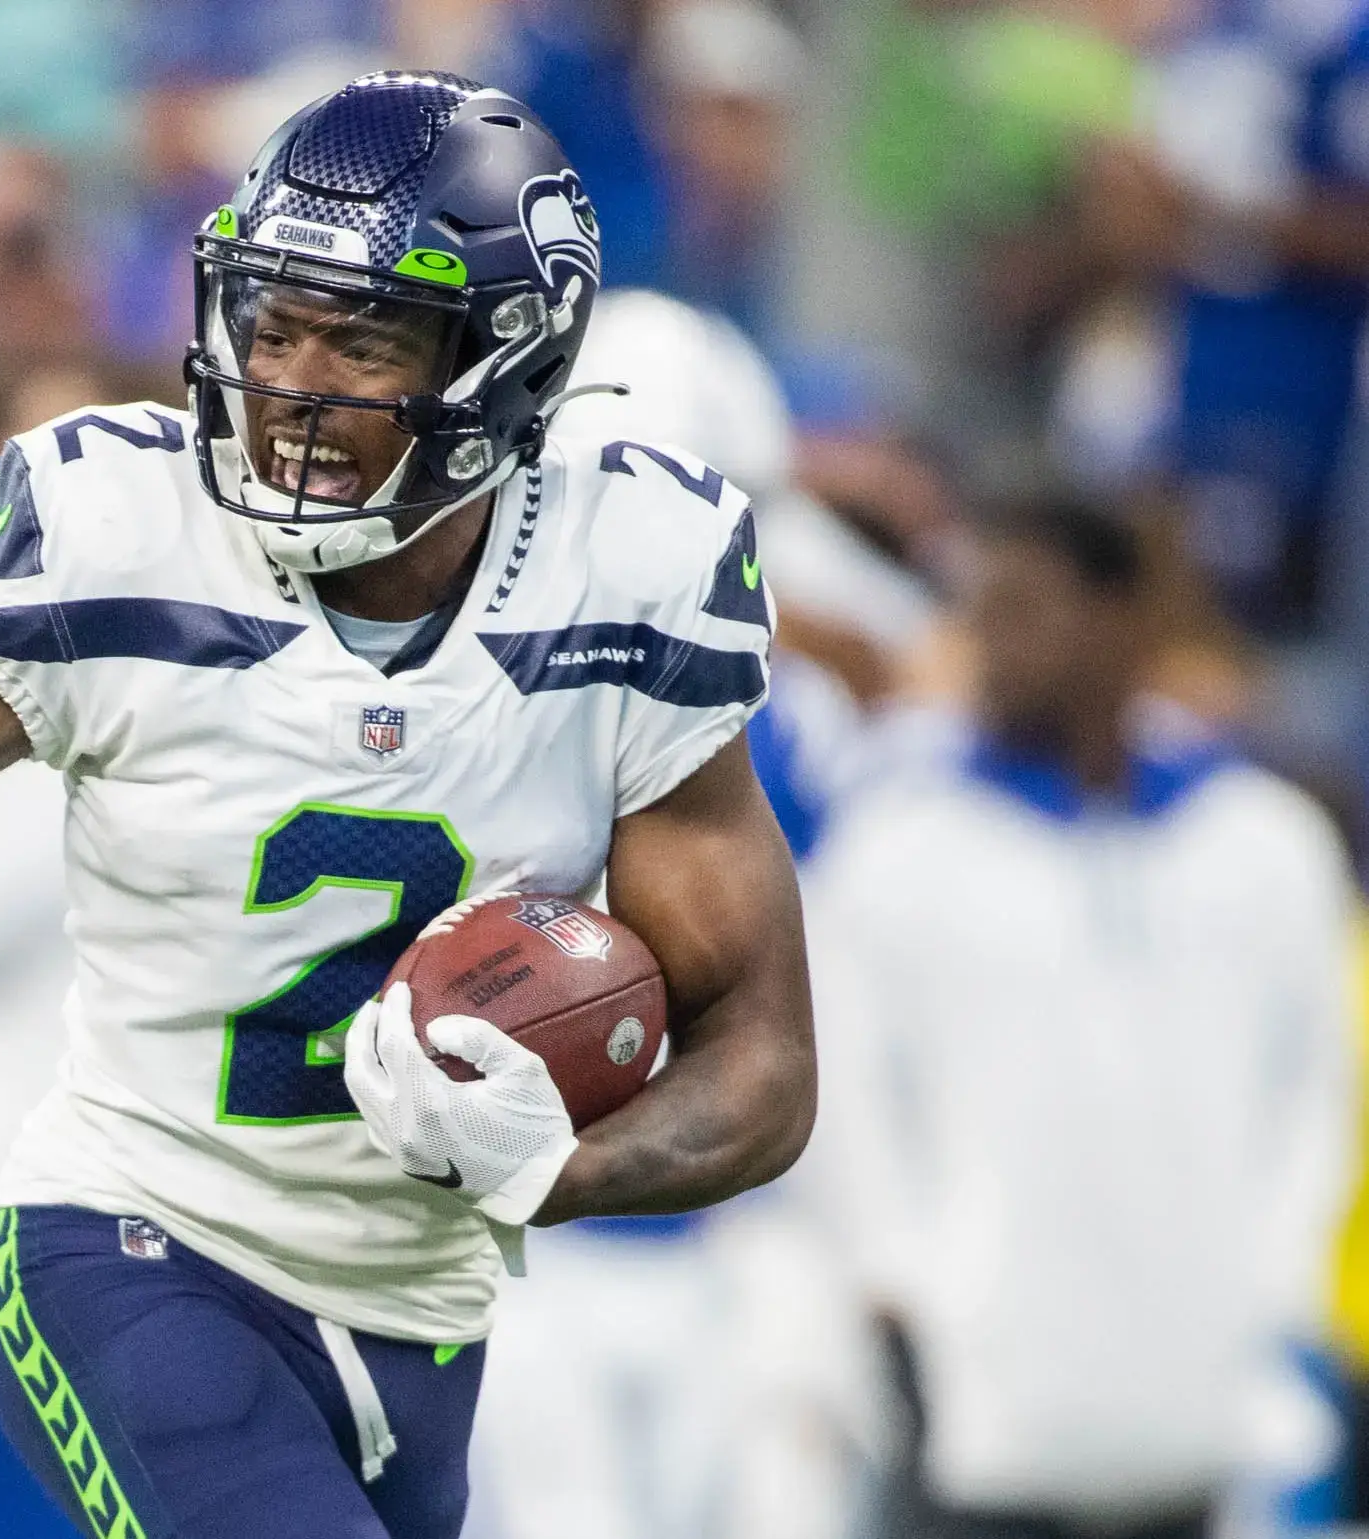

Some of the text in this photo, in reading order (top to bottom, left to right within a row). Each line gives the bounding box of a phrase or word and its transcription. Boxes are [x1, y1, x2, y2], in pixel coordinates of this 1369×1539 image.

[275, 223, 336, 249] SEAHAWKS
[365, 725, 398, 749] NFL
[215, 800, 476, 1128] 2
